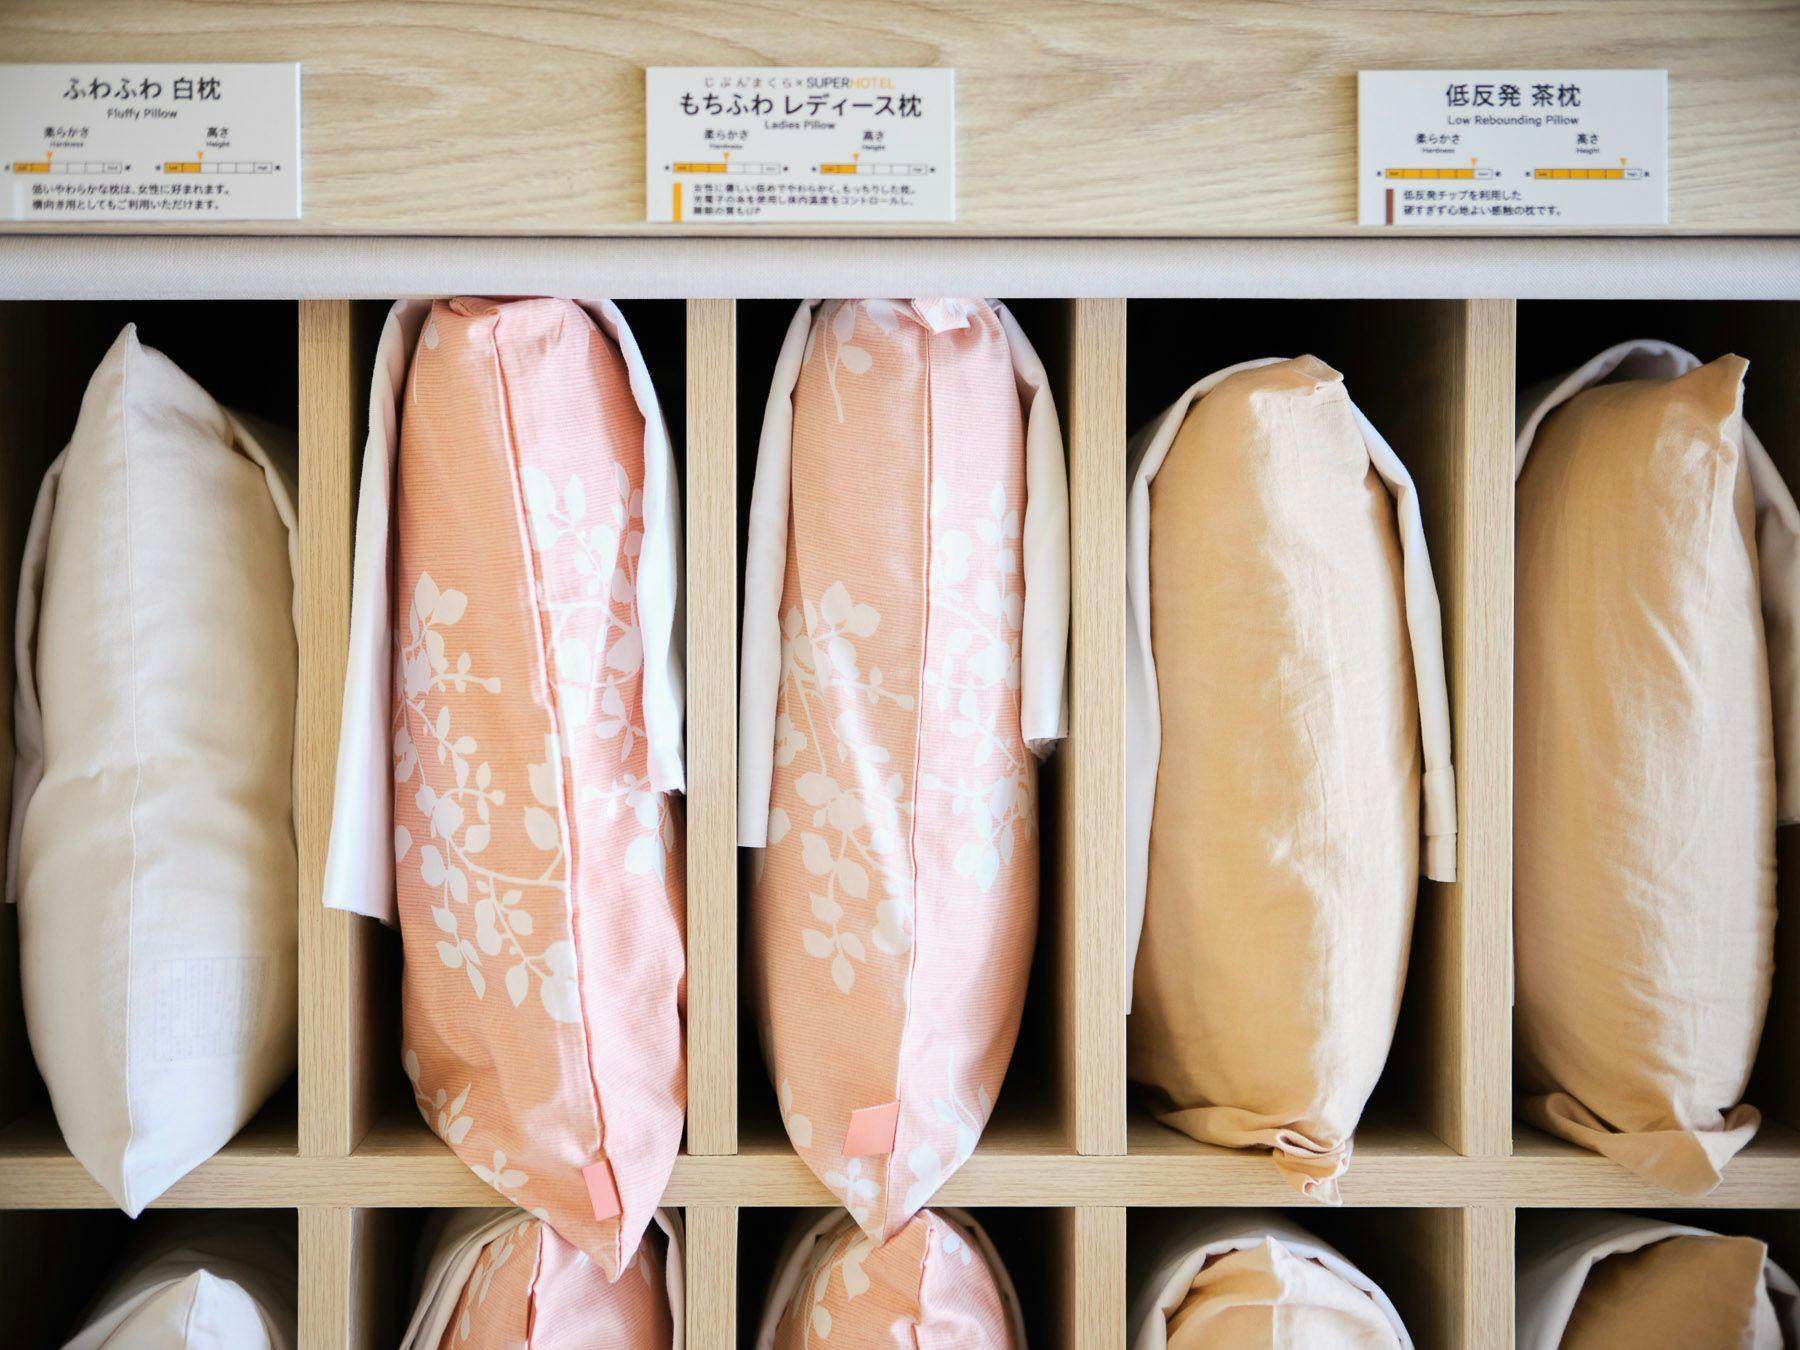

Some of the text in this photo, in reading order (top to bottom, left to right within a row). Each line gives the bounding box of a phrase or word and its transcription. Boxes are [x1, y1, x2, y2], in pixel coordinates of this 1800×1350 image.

[63, 76, 222, 101] ふわふわ 白枕
[1445, 83, 1582, 108] 低反発 茶枕
[680, 92, 923, 118] もちふわ レディース枕
[107, 108, 178, 120] Fluffy Pillow
[764, 120, 836, 130] Ladies Pillow
[1447, 115, 1580, 127] Low Rebounding Pillow
[44, 126, 90, 139] 柔らかさ
[206, 127, 229, 139] 高さ
[704, 129, 748, 140] 柔らかさ
[862, 130, 884, 141] 高さ
[1416, 133, 1461, 145] 柔らかさ
[1576, 133, 1600, 145] 高さ
[1403, 190, 1522, 202] 低反発チップを利用した
[1403, 205, 1562, 217] 硬すぎず心地よい感触の枕です。
